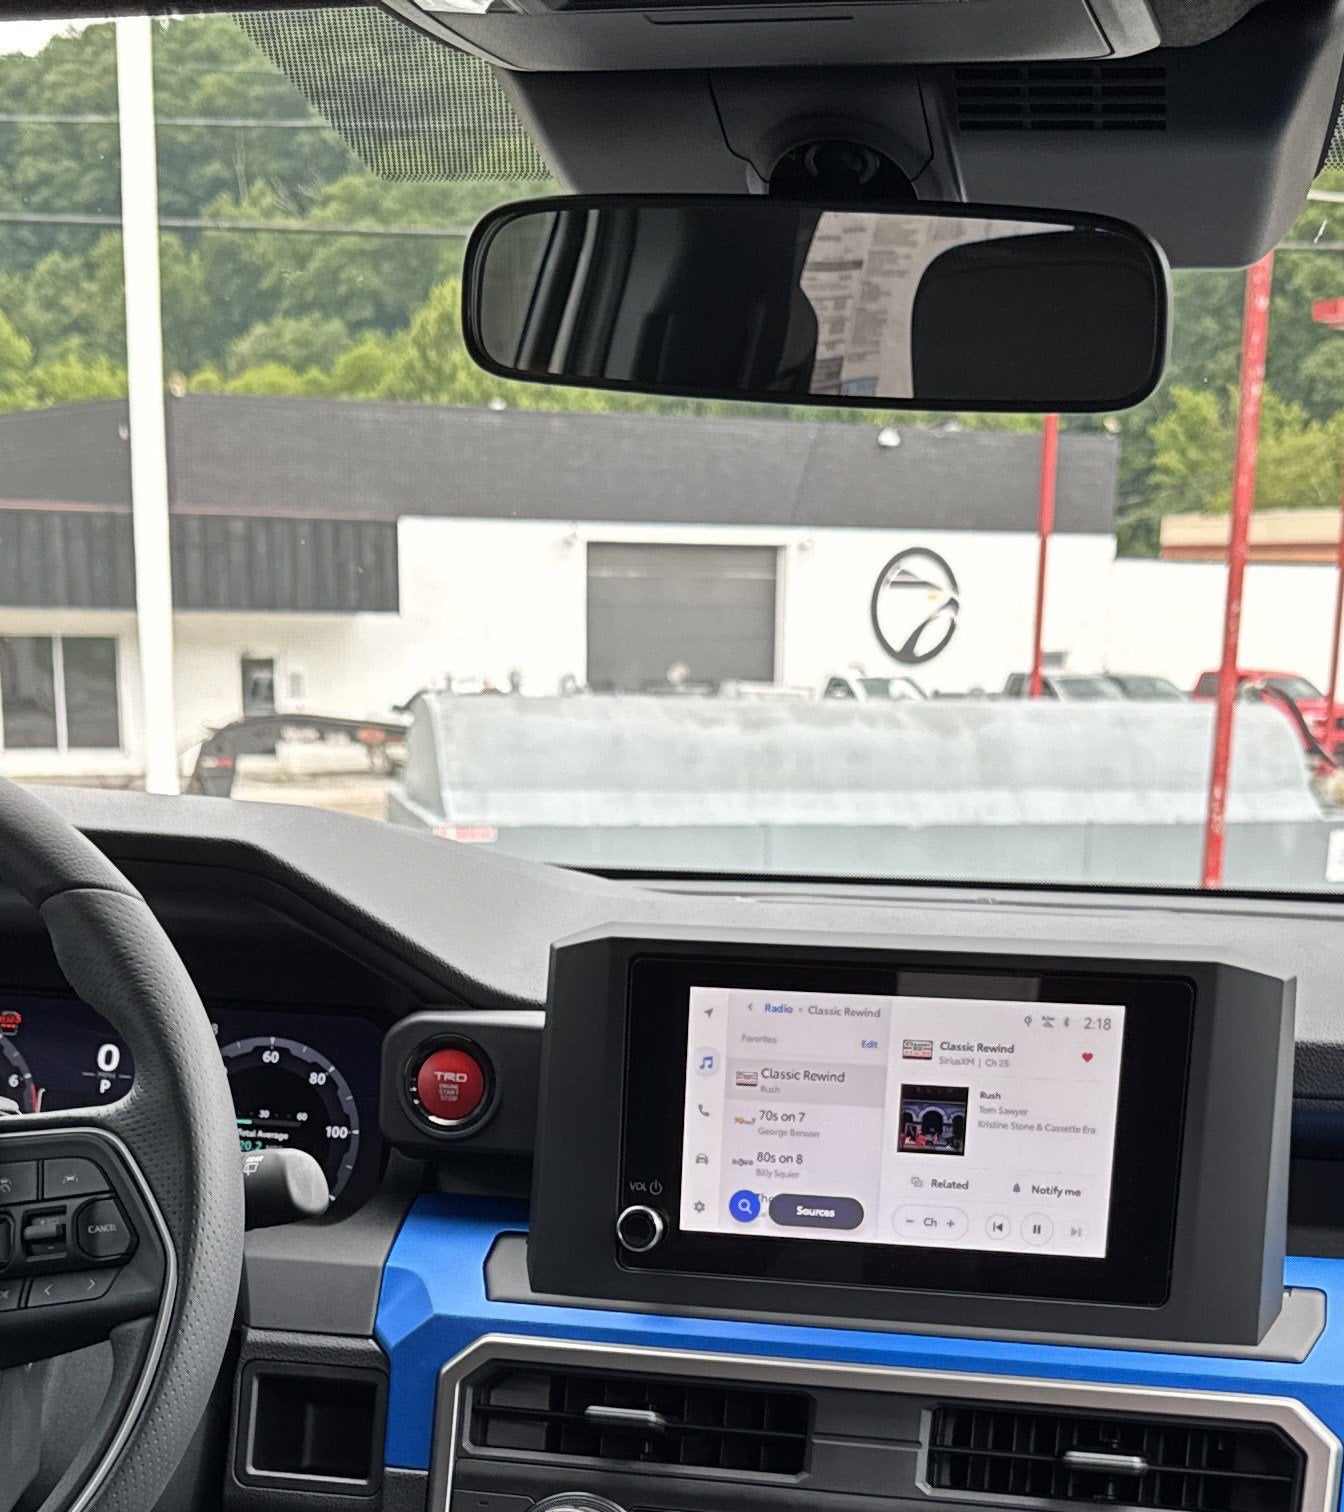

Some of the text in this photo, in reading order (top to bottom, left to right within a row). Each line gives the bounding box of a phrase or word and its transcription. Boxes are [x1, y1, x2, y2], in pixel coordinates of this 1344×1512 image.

[764, 1003, 793, 1014] Radio
[808, 1005, 881, 1018] Classic Rewind
[1084, 1017, 1112, 1031] 2:18
[741, 1034, 777, 1044] Favorites
[861, 1040, 879, 1049] Edit
[940, 1041, 974, 1052] Classic
[977, 1043, 1014, 1054] Rewind
[97, 1043, 120, 1072] 0
[262, 1050, 280, 1064] 60
[985, 1059, 998, 1067] Ch
[8, 1073, 19, 1088] 6
[309, 1072, 326, 1085] 80
[433, 1071, 468, 1083] TRD
[761, 1068, 846, 1083] Classic Rewind
[99, 1079, 111, 1094] P
[760, 1085, 780, 1094] Rush
[980, 1091, 1001, 1100] Rush
[759, 1110, 778, 1122] 70s
[781, 1113, 796, 1122] on
[798, 1112, 806, 1123] 7
[980, 1106, 1028, 1117] Tom Sawyer
[977, 1120, 1008, 1130] Kristine
[325, 1126, 348, 1139] 100
[757, 1127, 820, 1138] George Benson
[756, 1151, 776, 1163] 80s
[779, 1154, 793, 1164] on
[796, 1154, 803, 1165] 8
[931, 1179, 969, 1191] Related
[1031, 1185, 1082, 1198] Notify me
[796, 1205, 836, 1218] Sources
[87, 1223, 118, 1234] CANCEL
[923, 1217, 937, 1228] Ch
